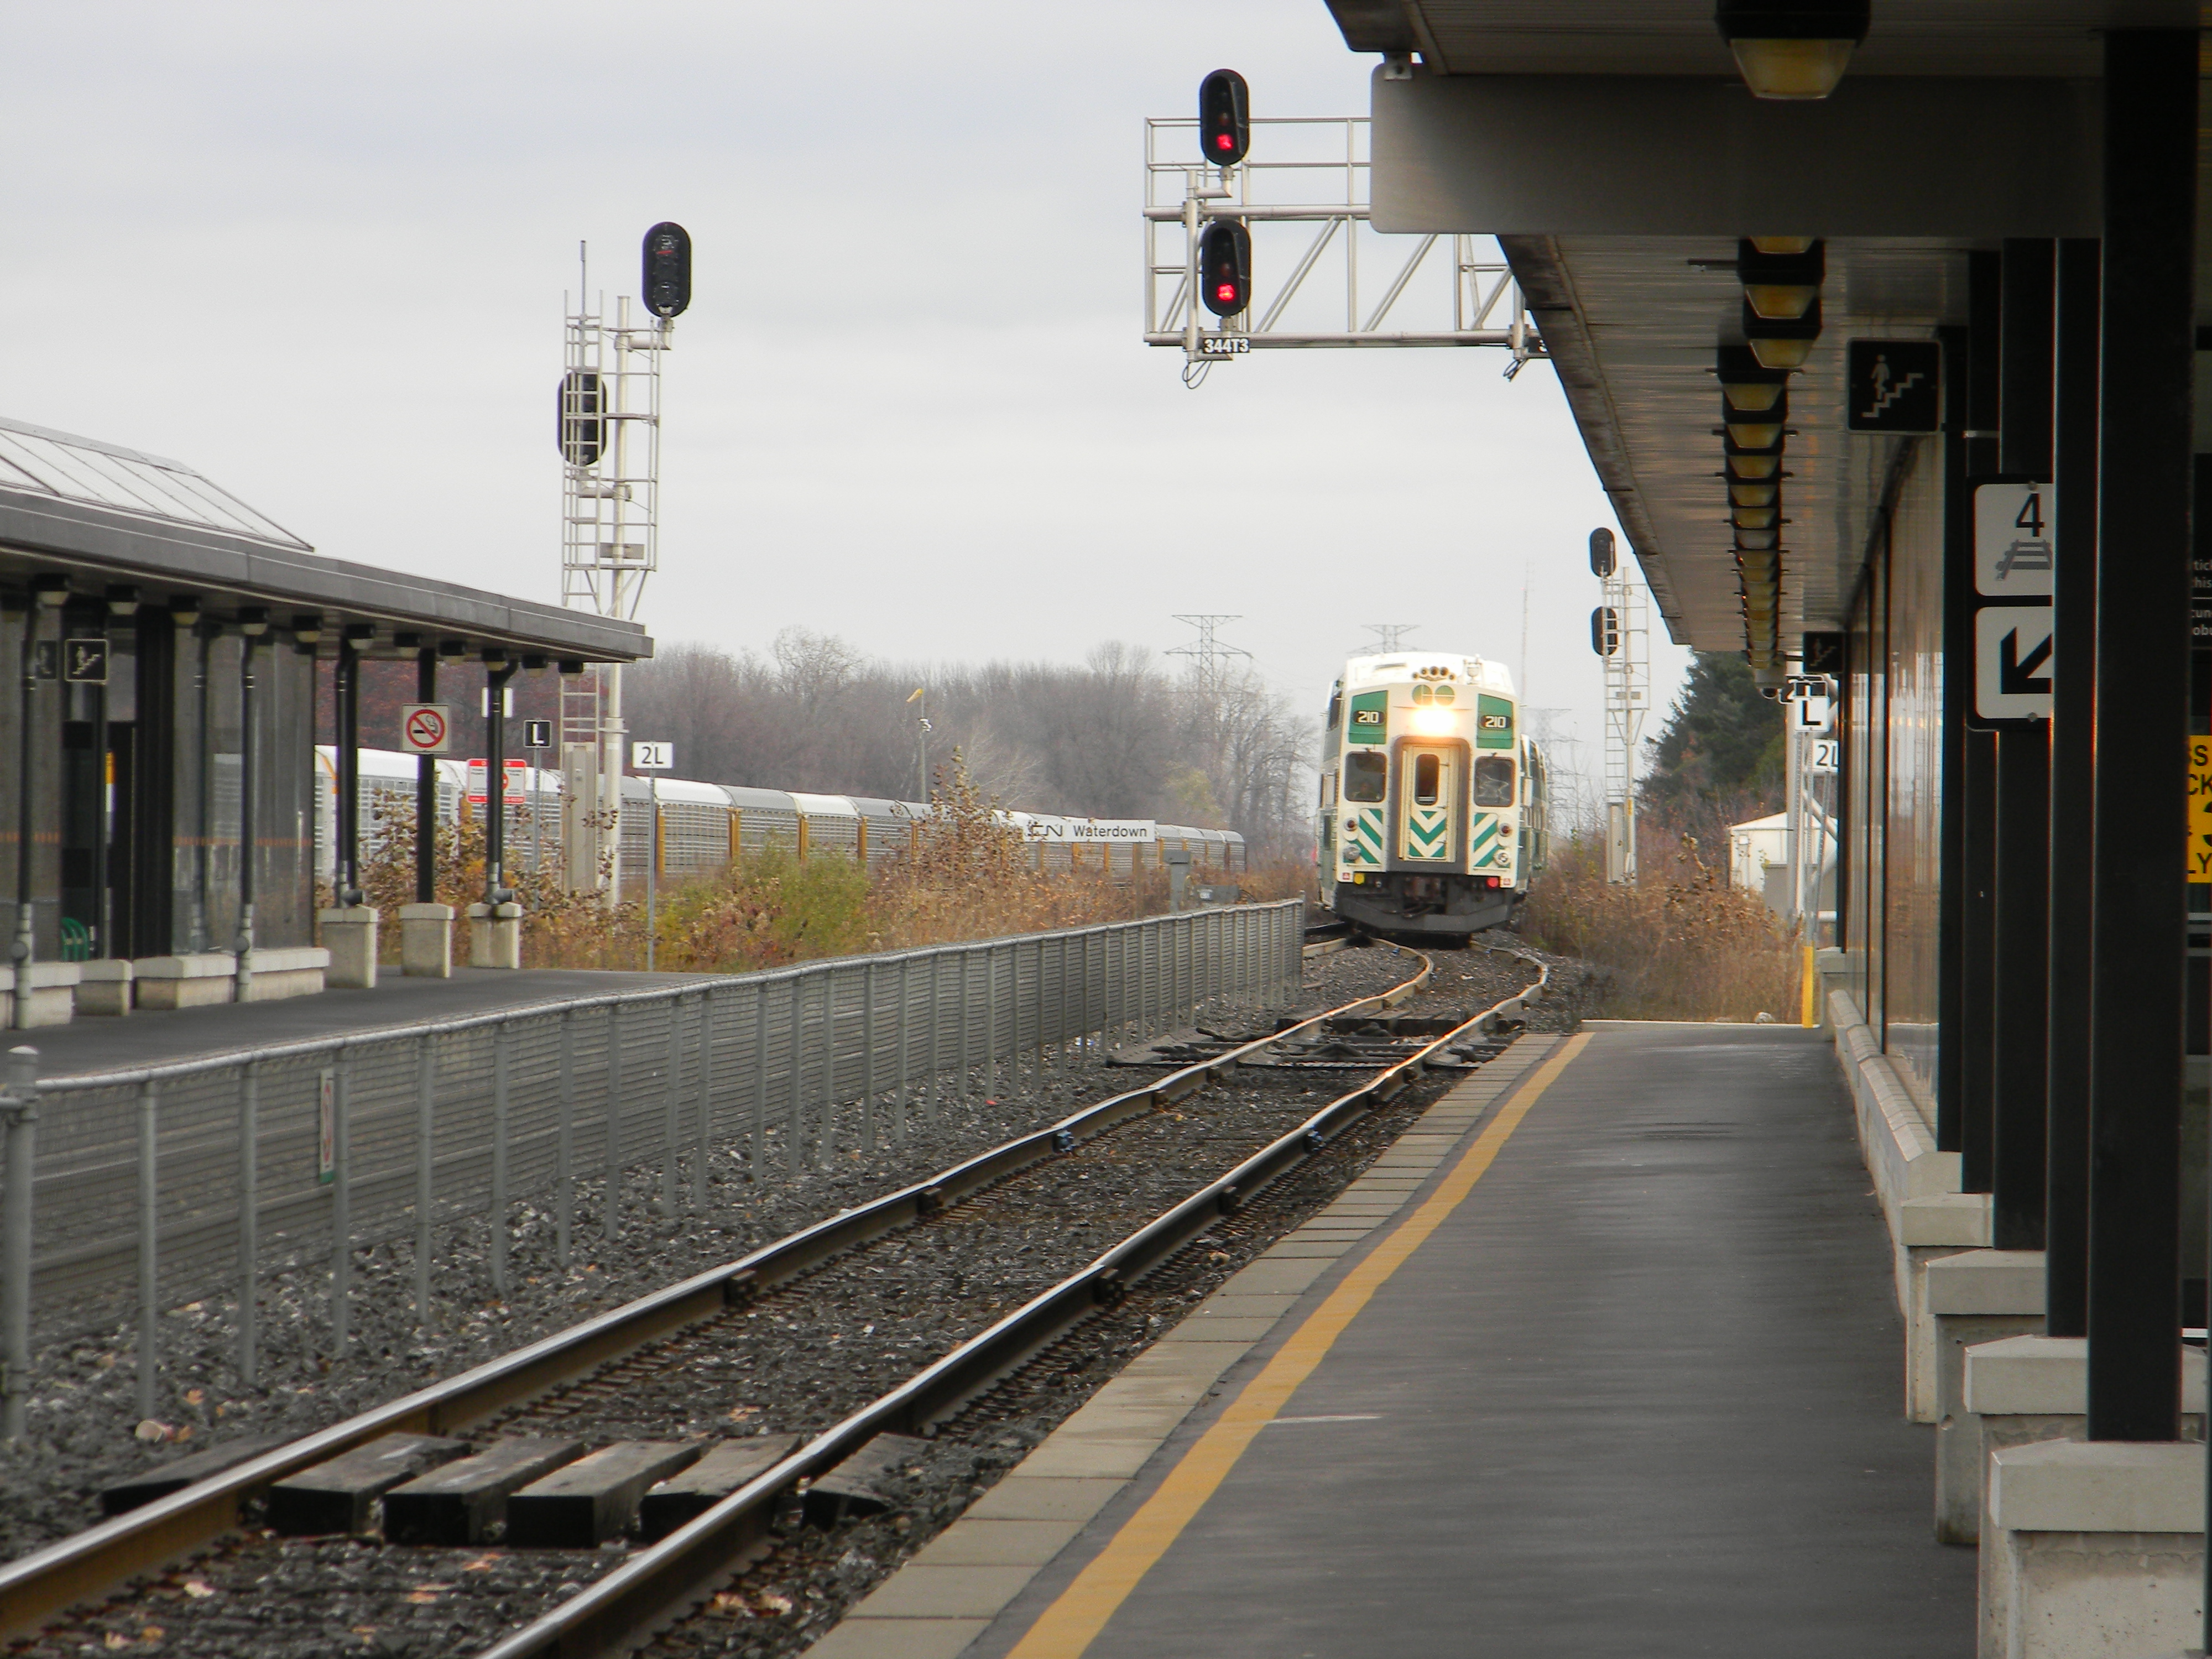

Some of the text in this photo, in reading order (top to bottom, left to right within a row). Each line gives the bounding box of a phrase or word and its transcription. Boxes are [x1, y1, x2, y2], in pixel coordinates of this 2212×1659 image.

[1204, 338, 1249, 353] 344T3
[2016, 493, 2045, 537] 4
[1358, 711, 1379, 723] 210
[1802, 700, 1822, 726] L
[1485, 716, 1506, 728] 210
[533, 723, 544, 744] L
[641, 747, 664, 764] 2L
[1073, 825, 1147, 837] Waterdown
